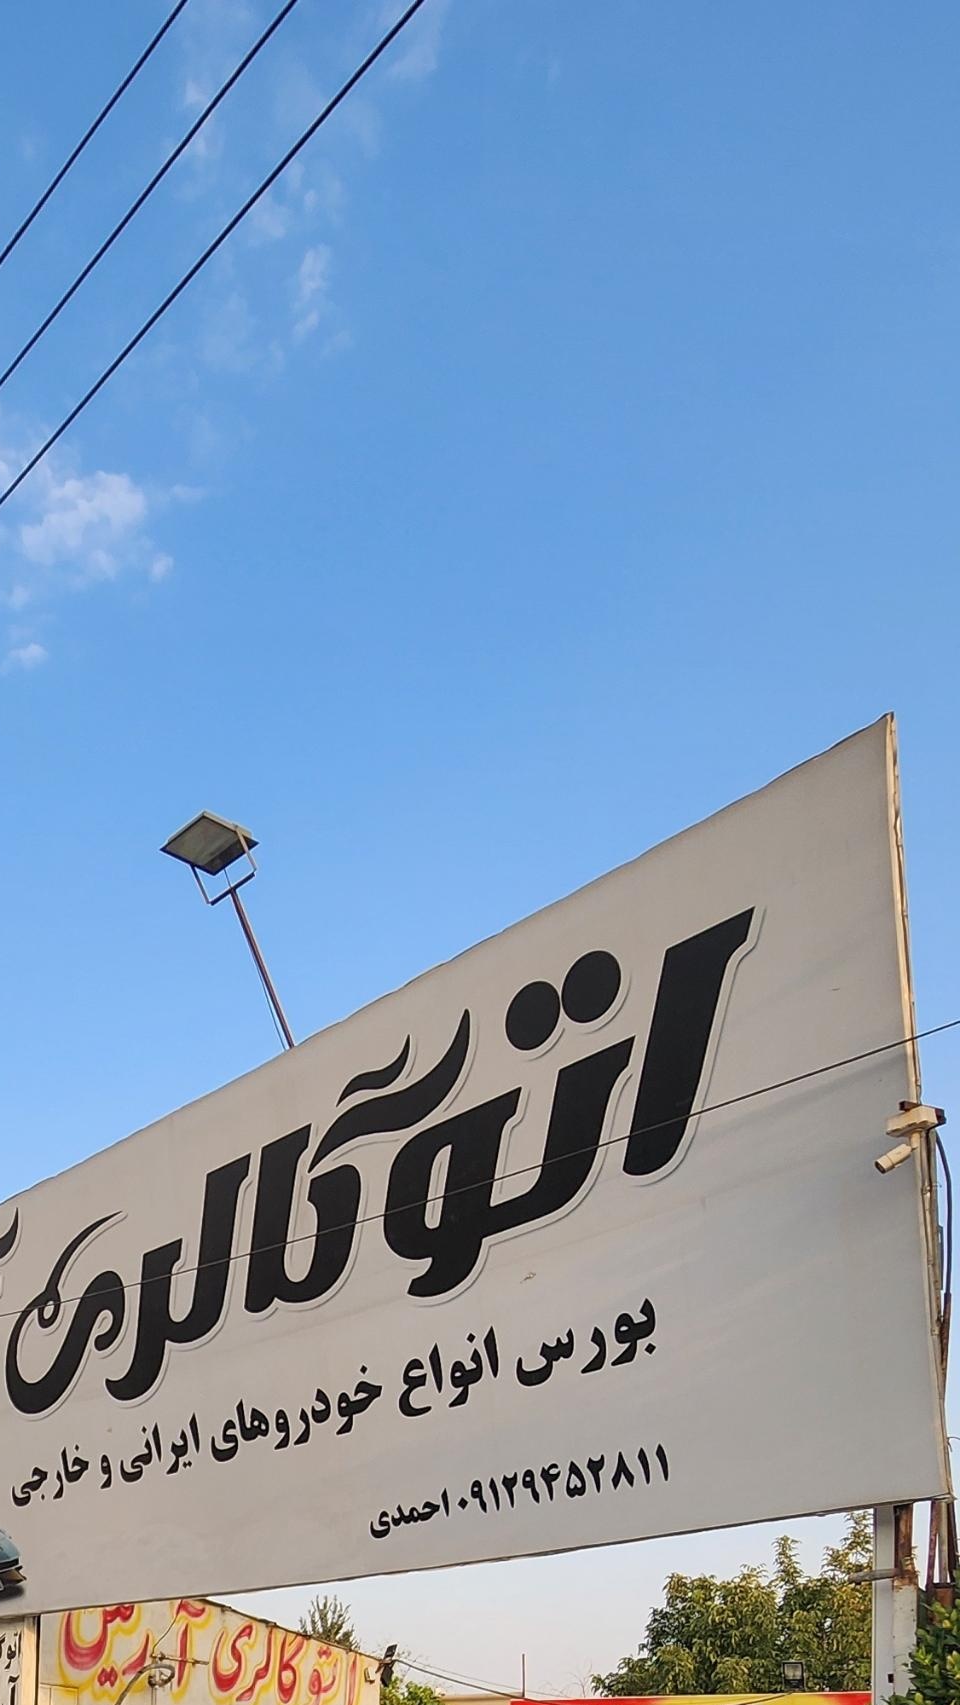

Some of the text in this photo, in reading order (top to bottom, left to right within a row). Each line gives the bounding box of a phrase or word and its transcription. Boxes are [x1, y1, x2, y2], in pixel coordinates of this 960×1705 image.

[398, 1325, 500, 1418] انواع
[515, 1297, 657, 1388] بورس
[11, 1444, 91, 1508] خارجی
[100, 1454, 113, 1490] و
[119, 1412, 201, 1484] ایرانی
[369, 1487, 450, 1539] احمدی
